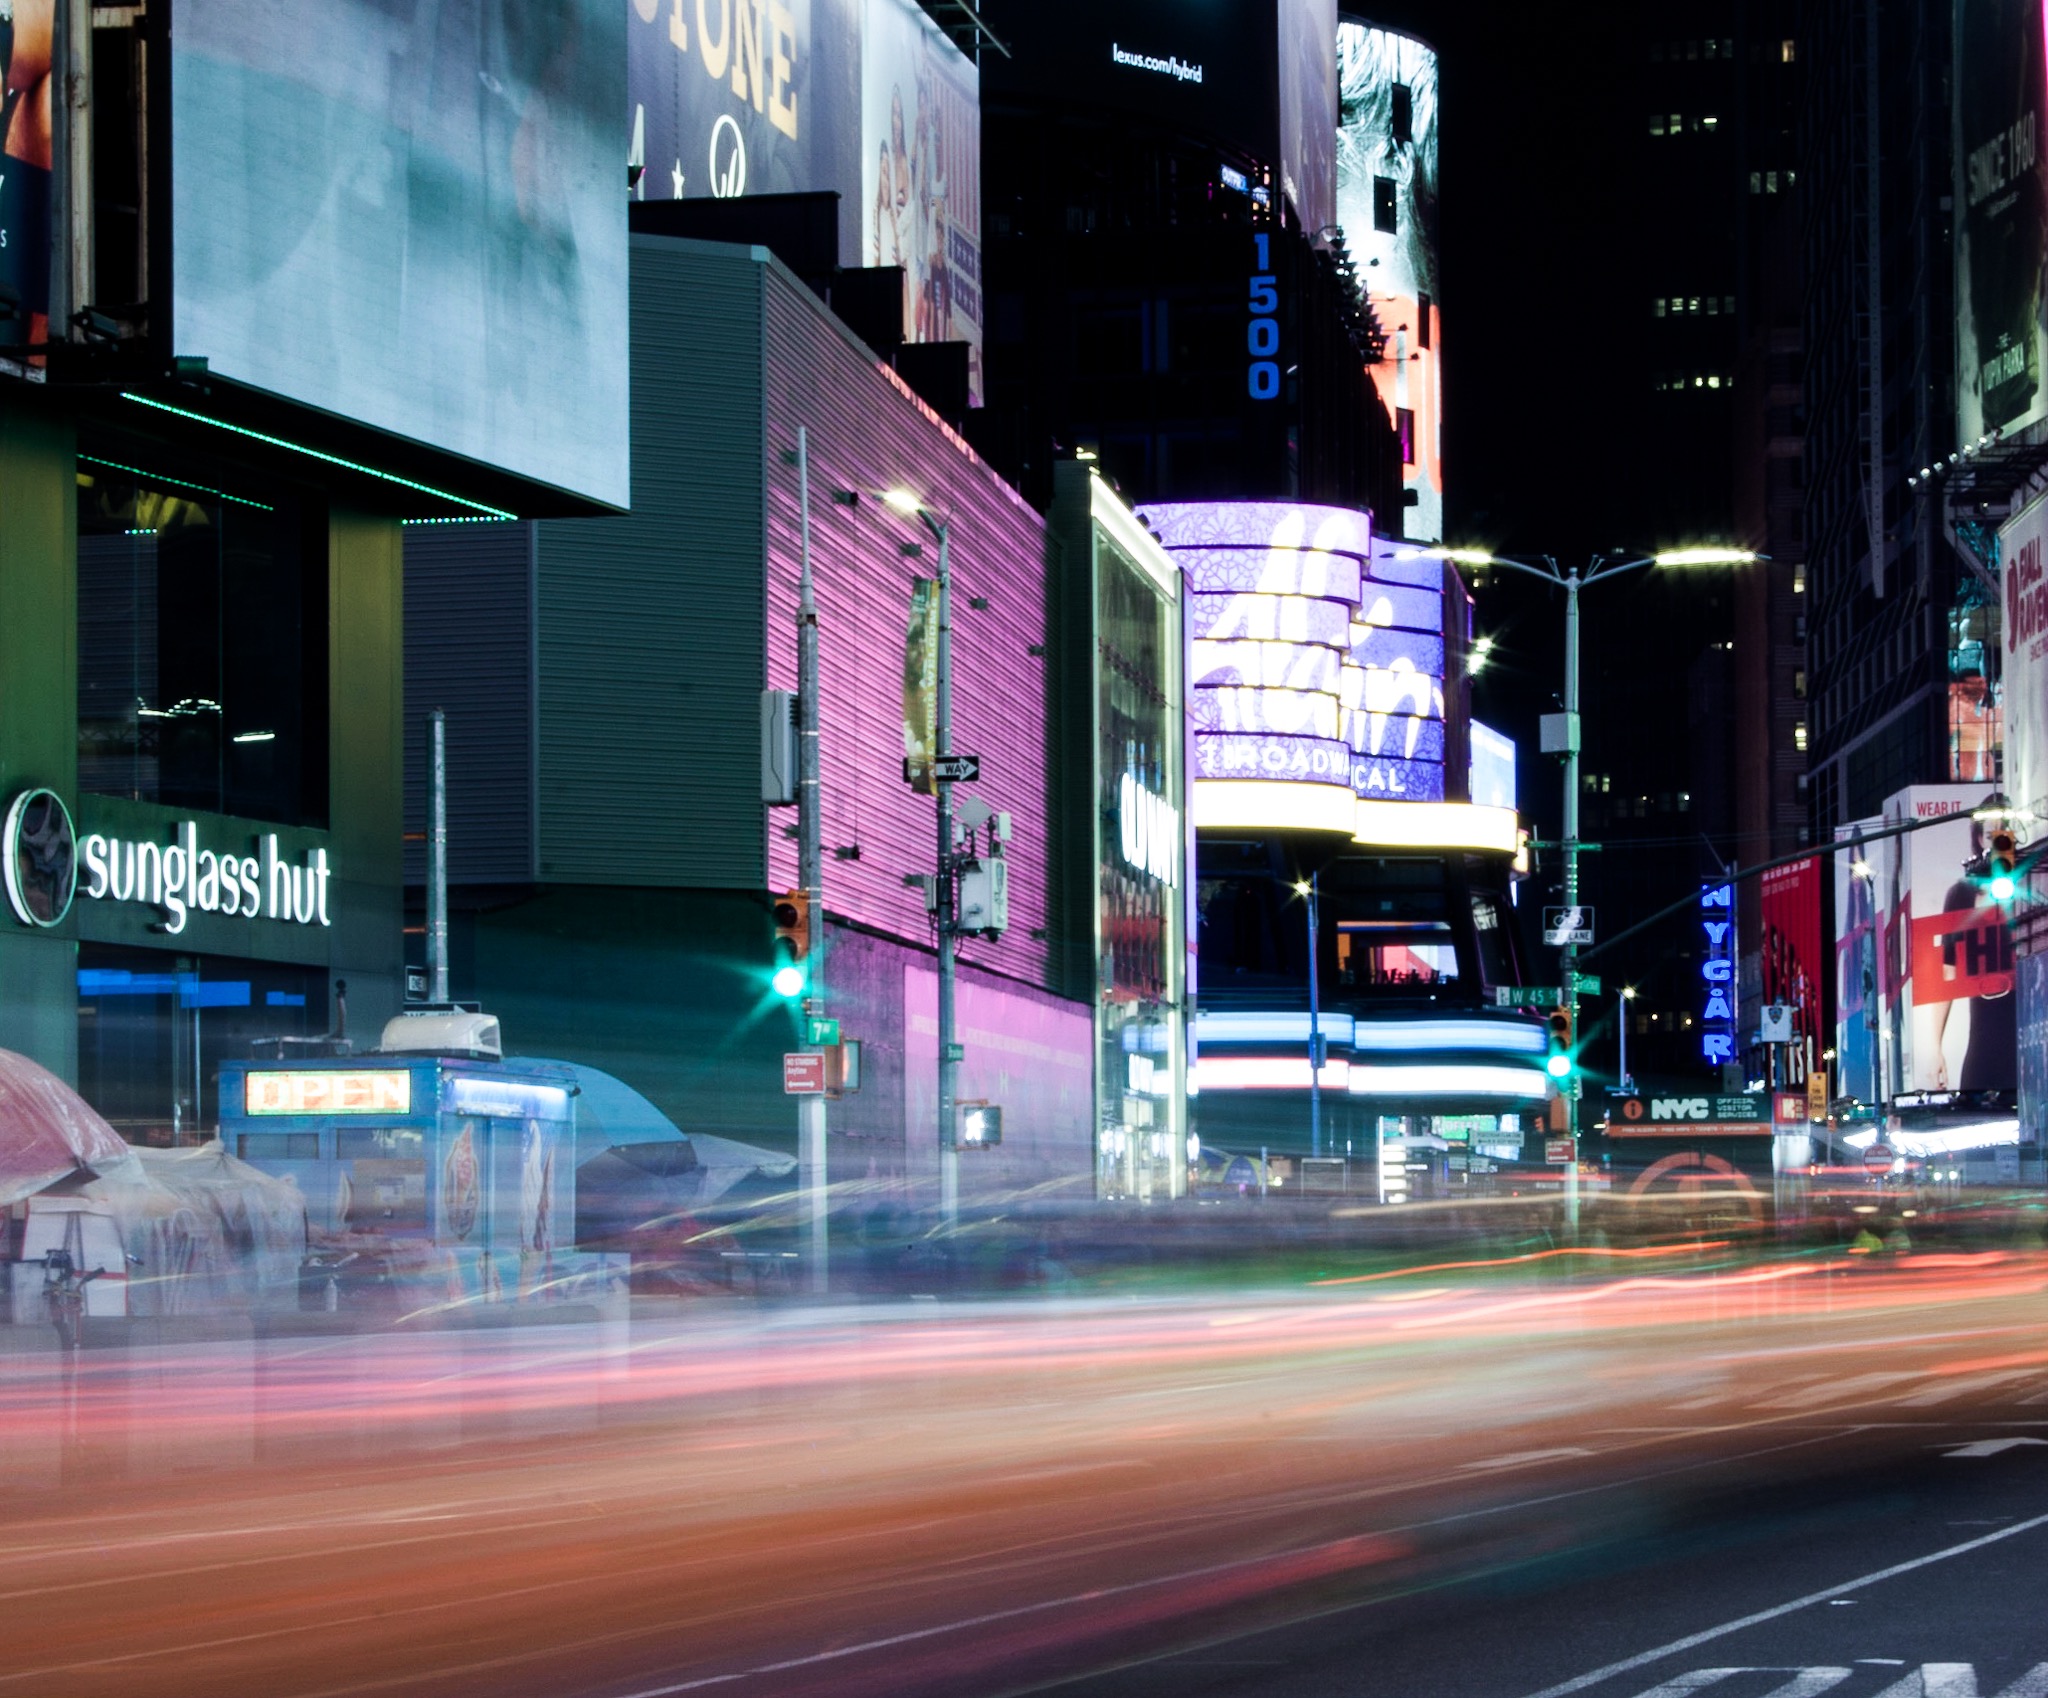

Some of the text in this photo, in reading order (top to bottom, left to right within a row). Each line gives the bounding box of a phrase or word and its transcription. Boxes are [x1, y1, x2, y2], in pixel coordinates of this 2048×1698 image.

[1113, 43, 1202, 83] lexus.com/hybrid
[1248, 233, 1279, 400] 1500
[927, 596, 938, 687] WELCOME
[944, 763, 969, 775] WAY
[1916, 801, 1948, 816] WEAR
[86, 820, 331, 934] sunglass hut
[1512, 989, 1523, 1003] W
[1529, 989, 1544, 1004] 45
[253, 1075, 409, 1111] OPEN
[1651, 1098, 1709, 1120] NYC
